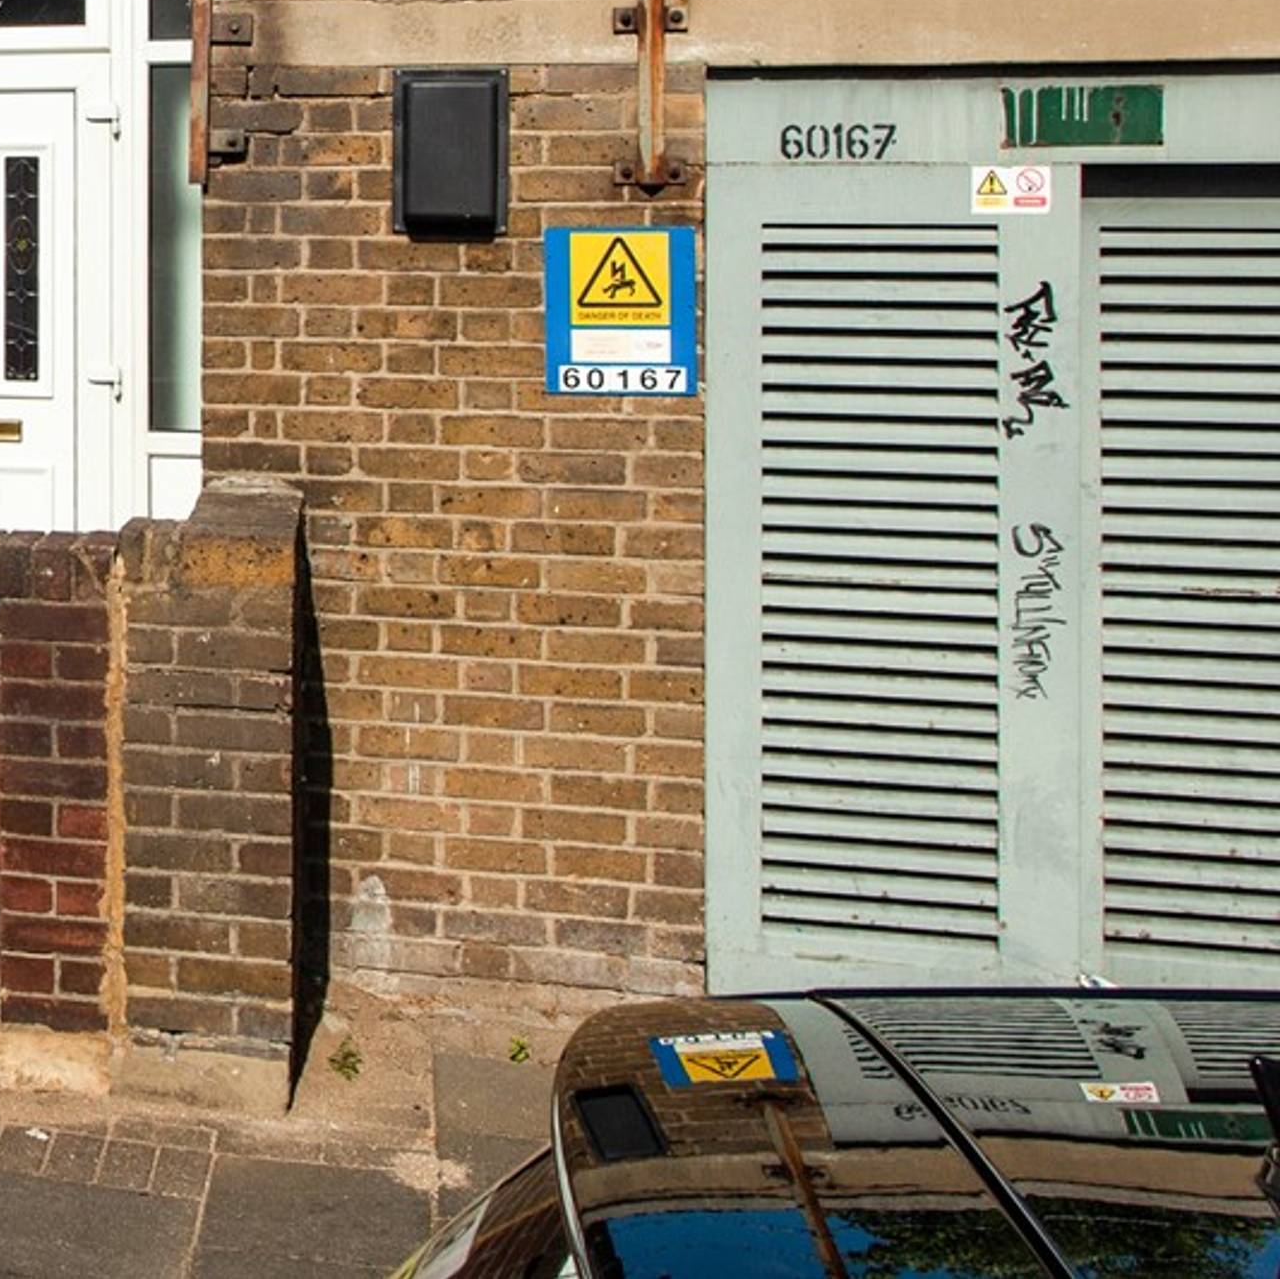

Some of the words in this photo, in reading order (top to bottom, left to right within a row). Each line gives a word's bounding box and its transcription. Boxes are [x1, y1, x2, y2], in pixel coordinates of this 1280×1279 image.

[781, 123, 897, 160] 60167
[578, 312, 616, 321] DANGER
[632, 312, 661, 321] DEATH
[562, 368, 682, 390] 60167
